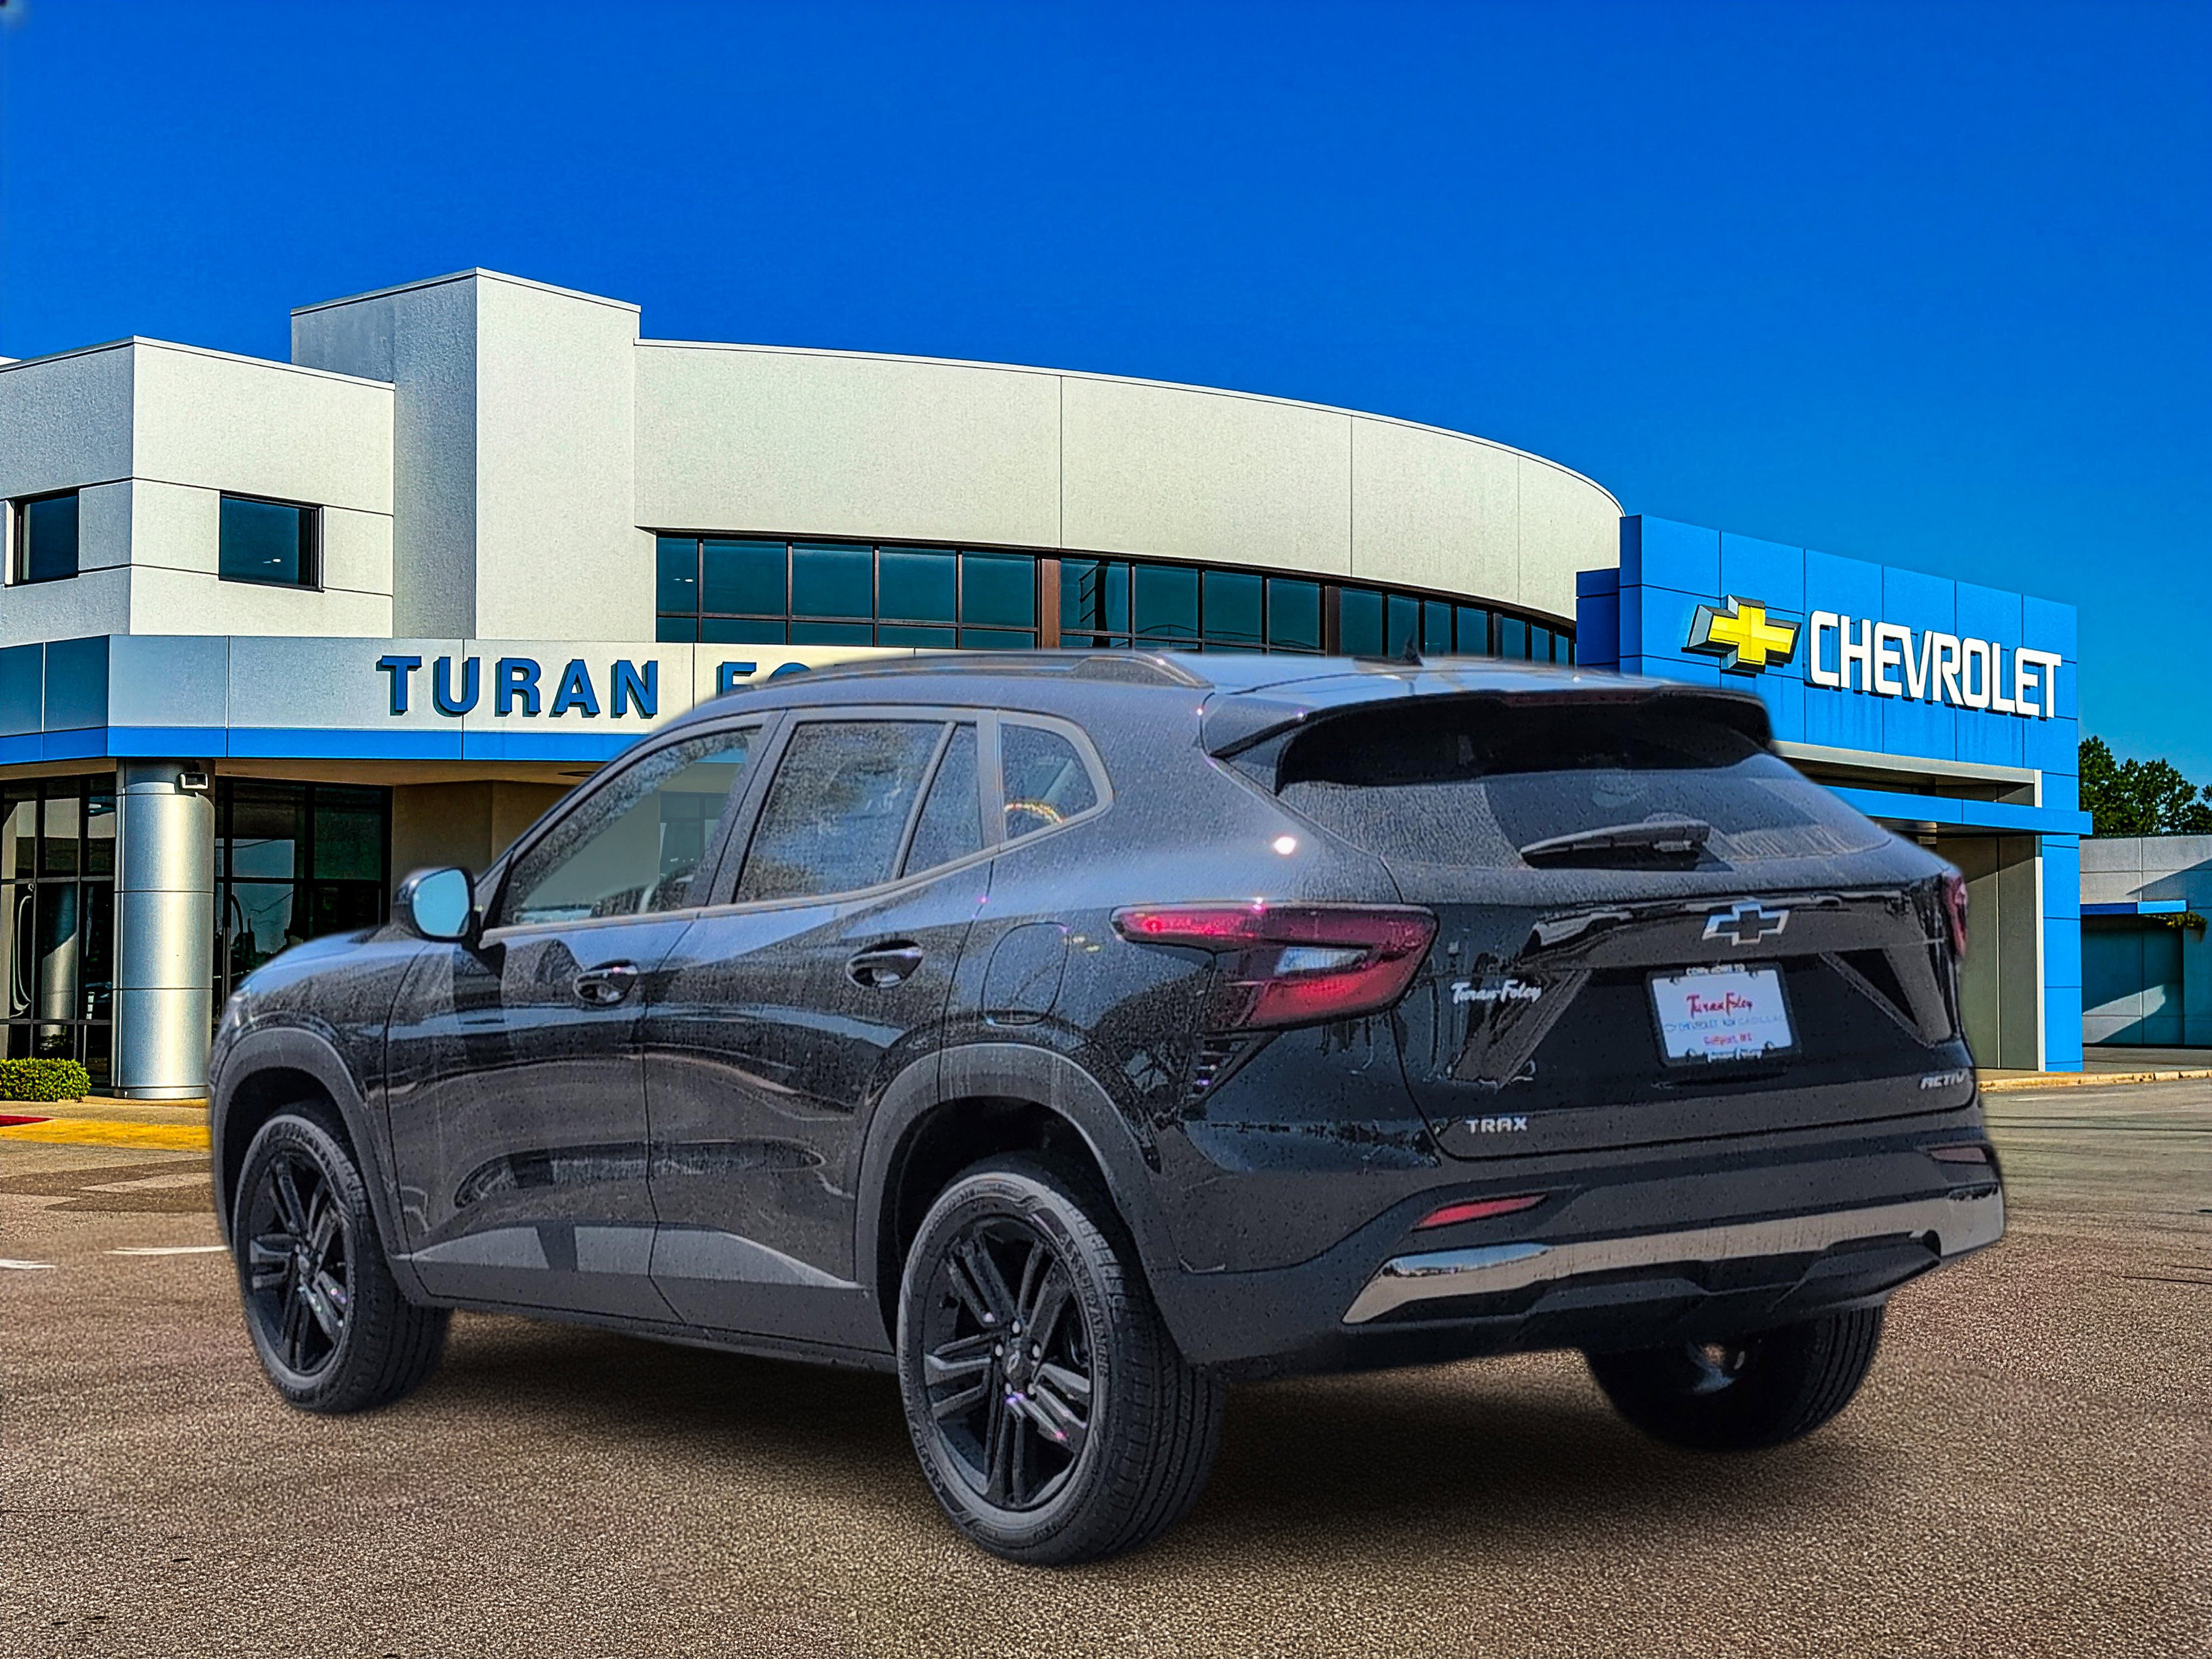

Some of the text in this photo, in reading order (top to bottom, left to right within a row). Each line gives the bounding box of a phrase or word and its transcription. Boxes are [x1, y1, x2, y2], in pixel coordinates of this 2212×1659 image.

[1808, 610, 2062, 718] CHEVROLET
[377, 655, 658, 718] TURAN
[1920, 1069, 1969, 1089] ACTIV
[1465, 1117, 1527, 1134] TRAX
